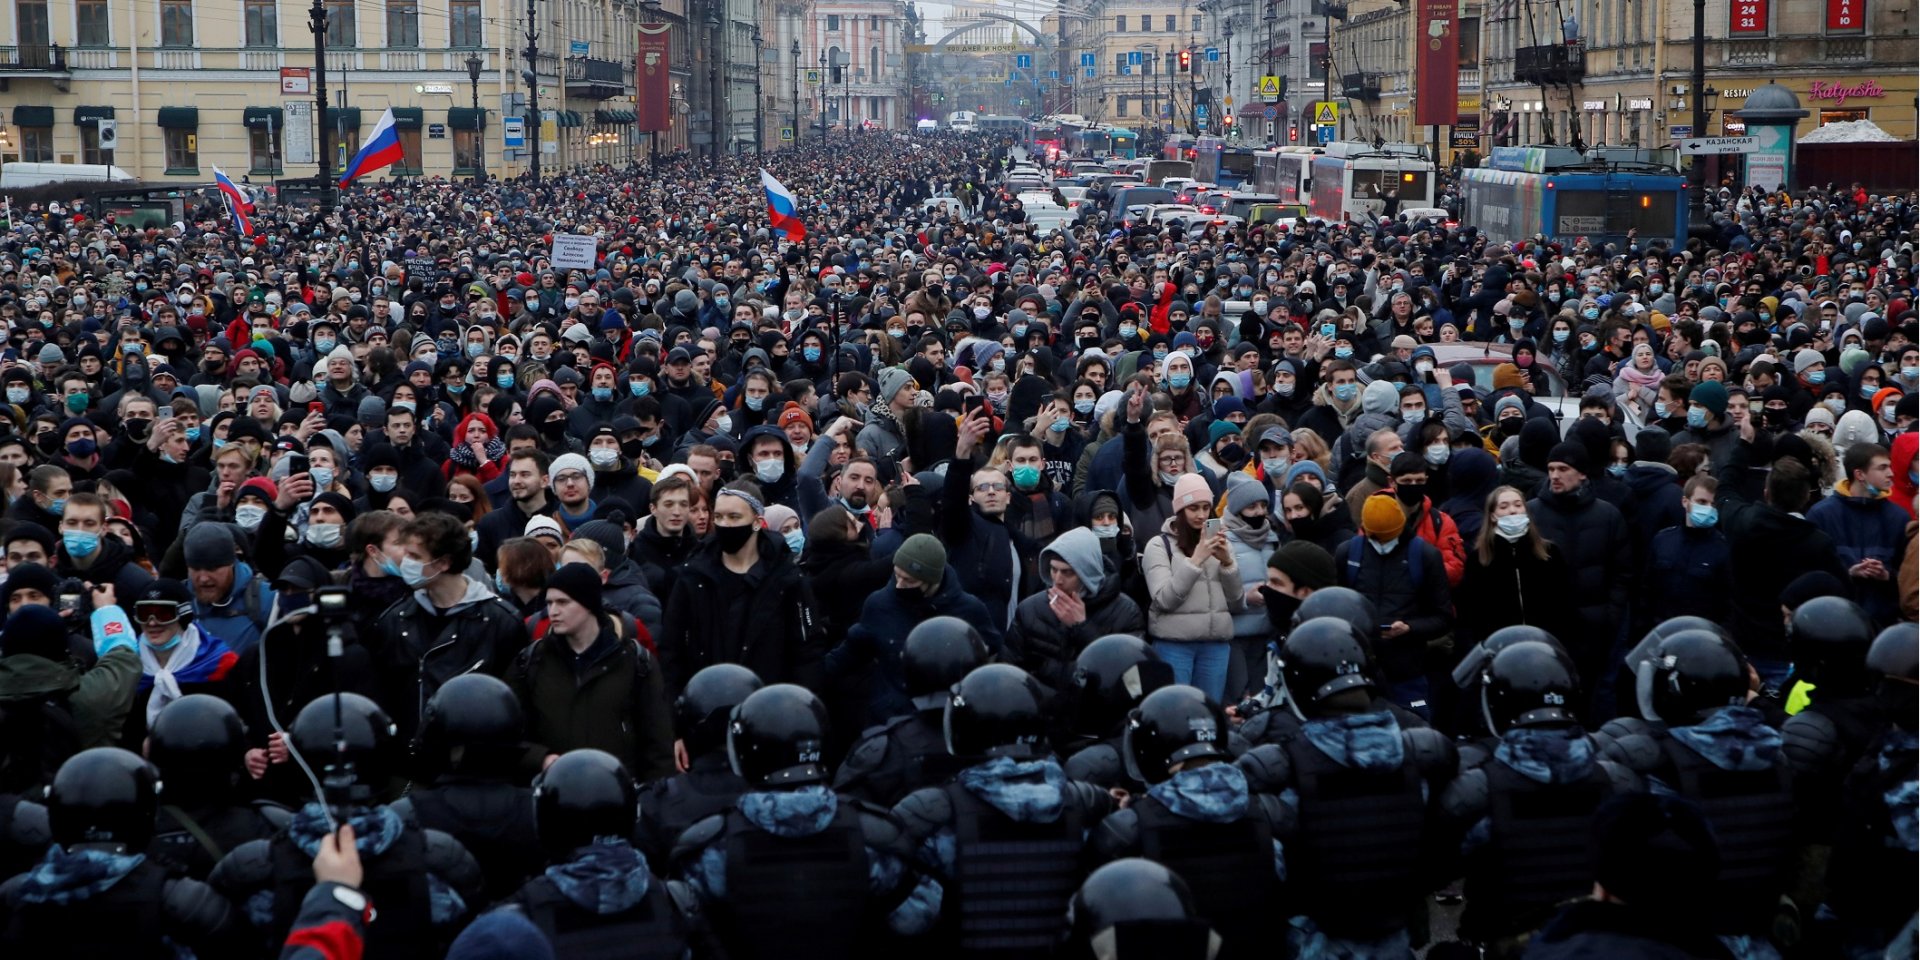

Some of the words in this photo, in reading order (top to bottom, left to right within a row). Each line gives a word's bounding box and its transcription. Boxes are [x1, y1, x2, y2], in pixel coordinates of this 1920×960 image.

[1741, 6, 1756, 15] 24
[1741, 18, 1755, 27] 31
[1723, 89, 1756, 98] RESTAU
[1808, 80, 1887, 106] Katyusha
[1706, 137, 1753, 145] КАЗАНСКАЯ
